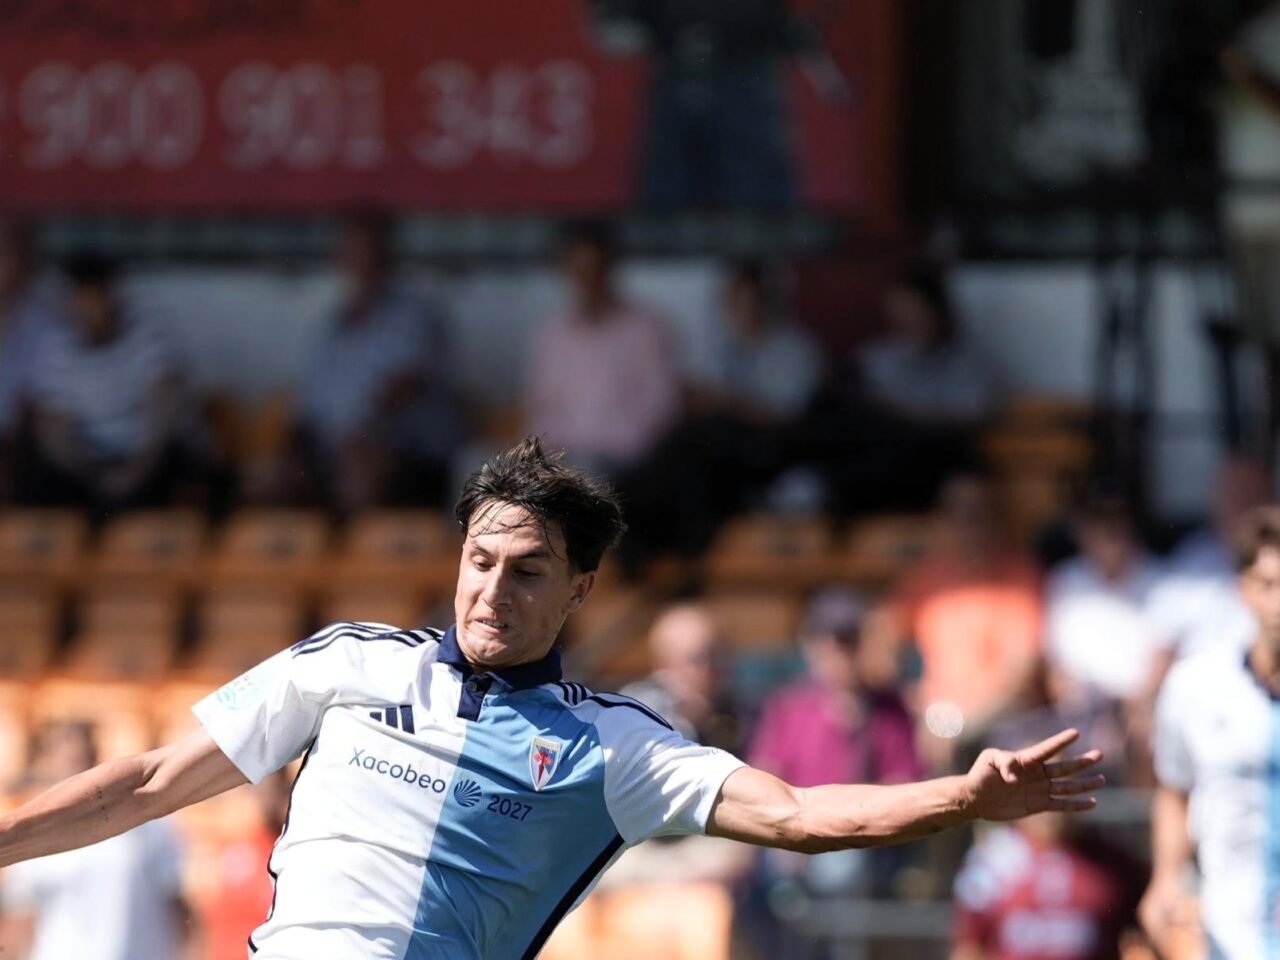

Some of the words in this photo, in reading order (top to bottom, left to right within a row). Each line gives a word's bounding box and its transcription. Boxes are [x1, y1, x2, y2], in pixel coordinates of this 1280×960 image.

[20, 60, 204, 169] 900
[409, 60, 595, 168] 343
[348, 747, 446, 793] Xacobeo
[486, 794, 532, 821] 2027
